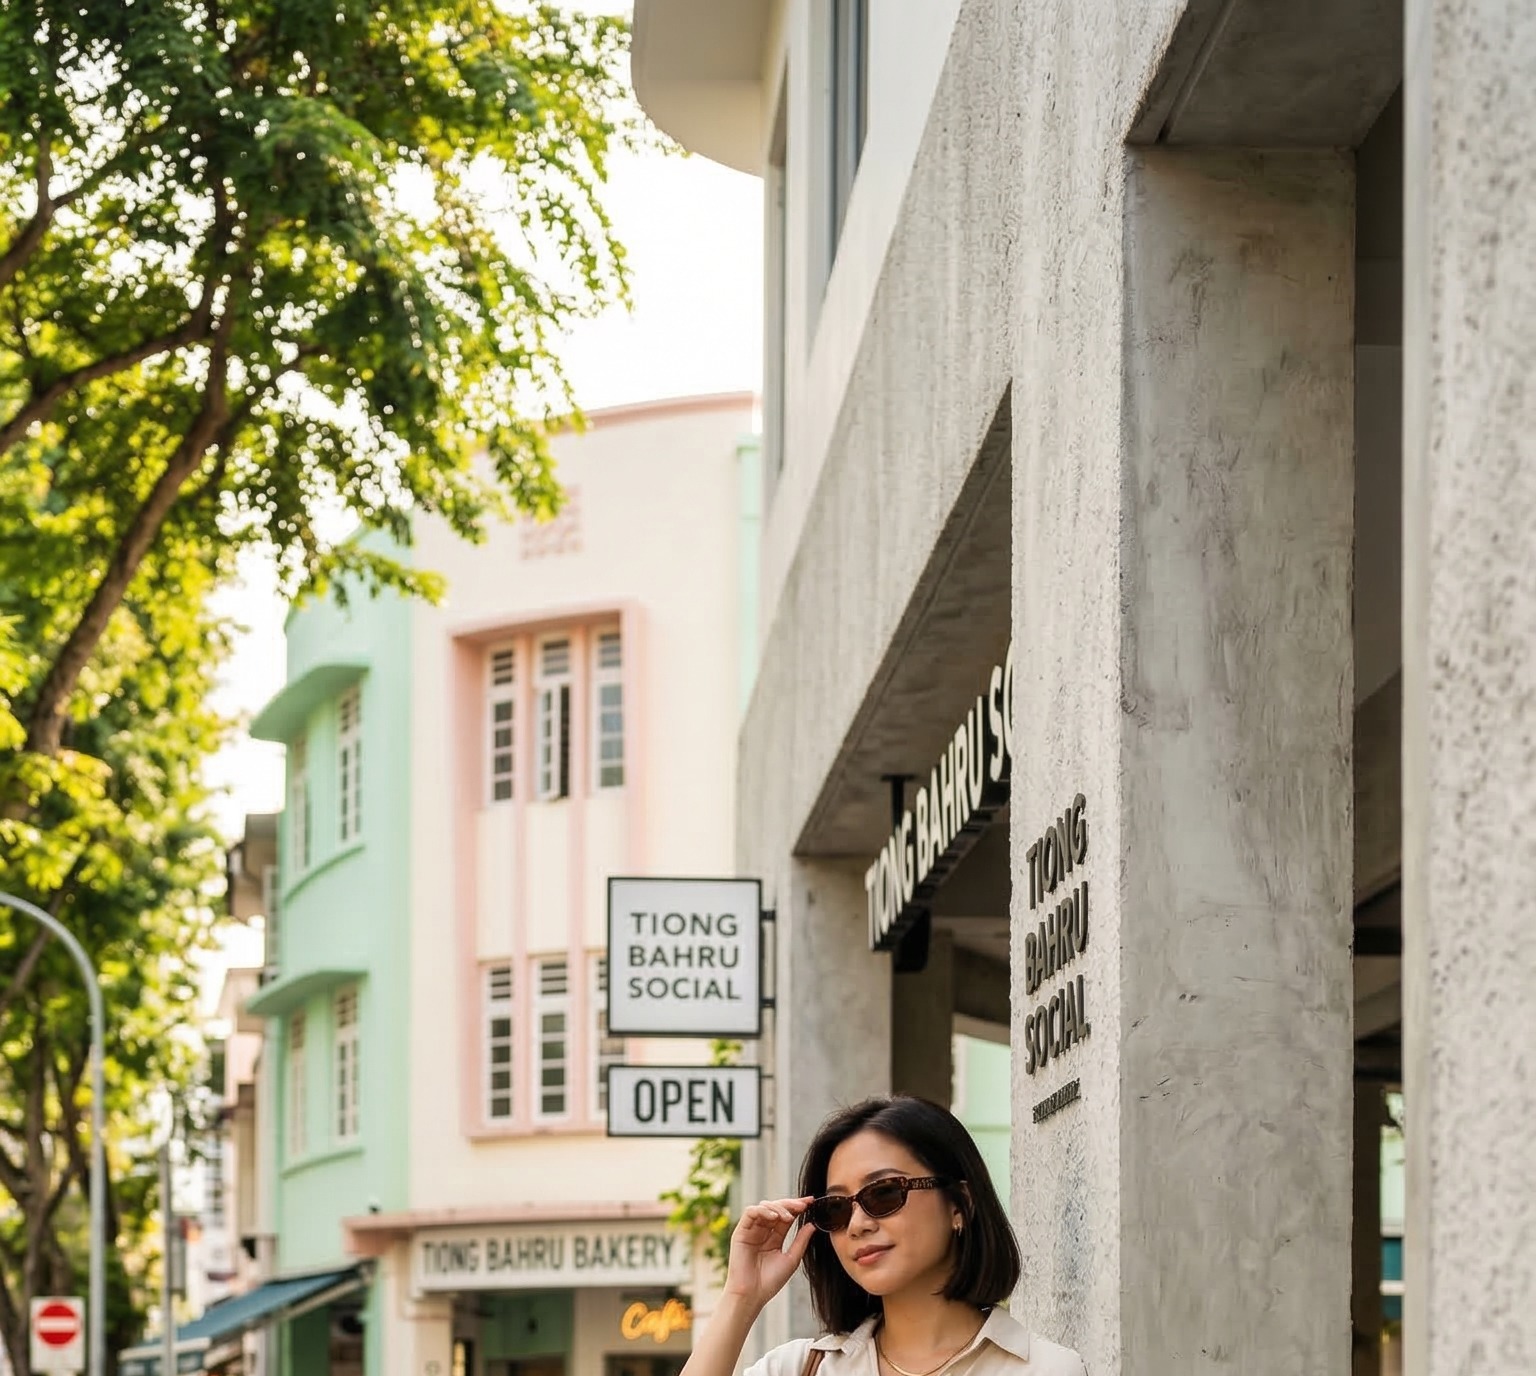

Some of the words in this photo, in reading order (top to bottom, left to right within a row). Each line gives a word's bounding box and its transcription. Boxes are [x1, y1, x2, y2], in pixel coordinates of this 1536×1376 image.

[864, 809, 915, 951] TIONG
[915, 695, 984, 884] BAHRU
[1026, 793, 1087, 910] TIONG
[630, 912, 738, 937] TIONG
[1025, 881, 1089, 996] BAHRU
[629, 945, 740, 968] BAHRU
[629, 977, 741, 1000] SOCIAL
[1025, 974, 1090, 1076] SOCIAL
[633, 1079, 734, 1124] OPEN
[423, 1239, 480, 1276] TIONG
[486, 1236, 564, 1272] BAHRU
[573, 1233, 676, 1268] BAKERY
